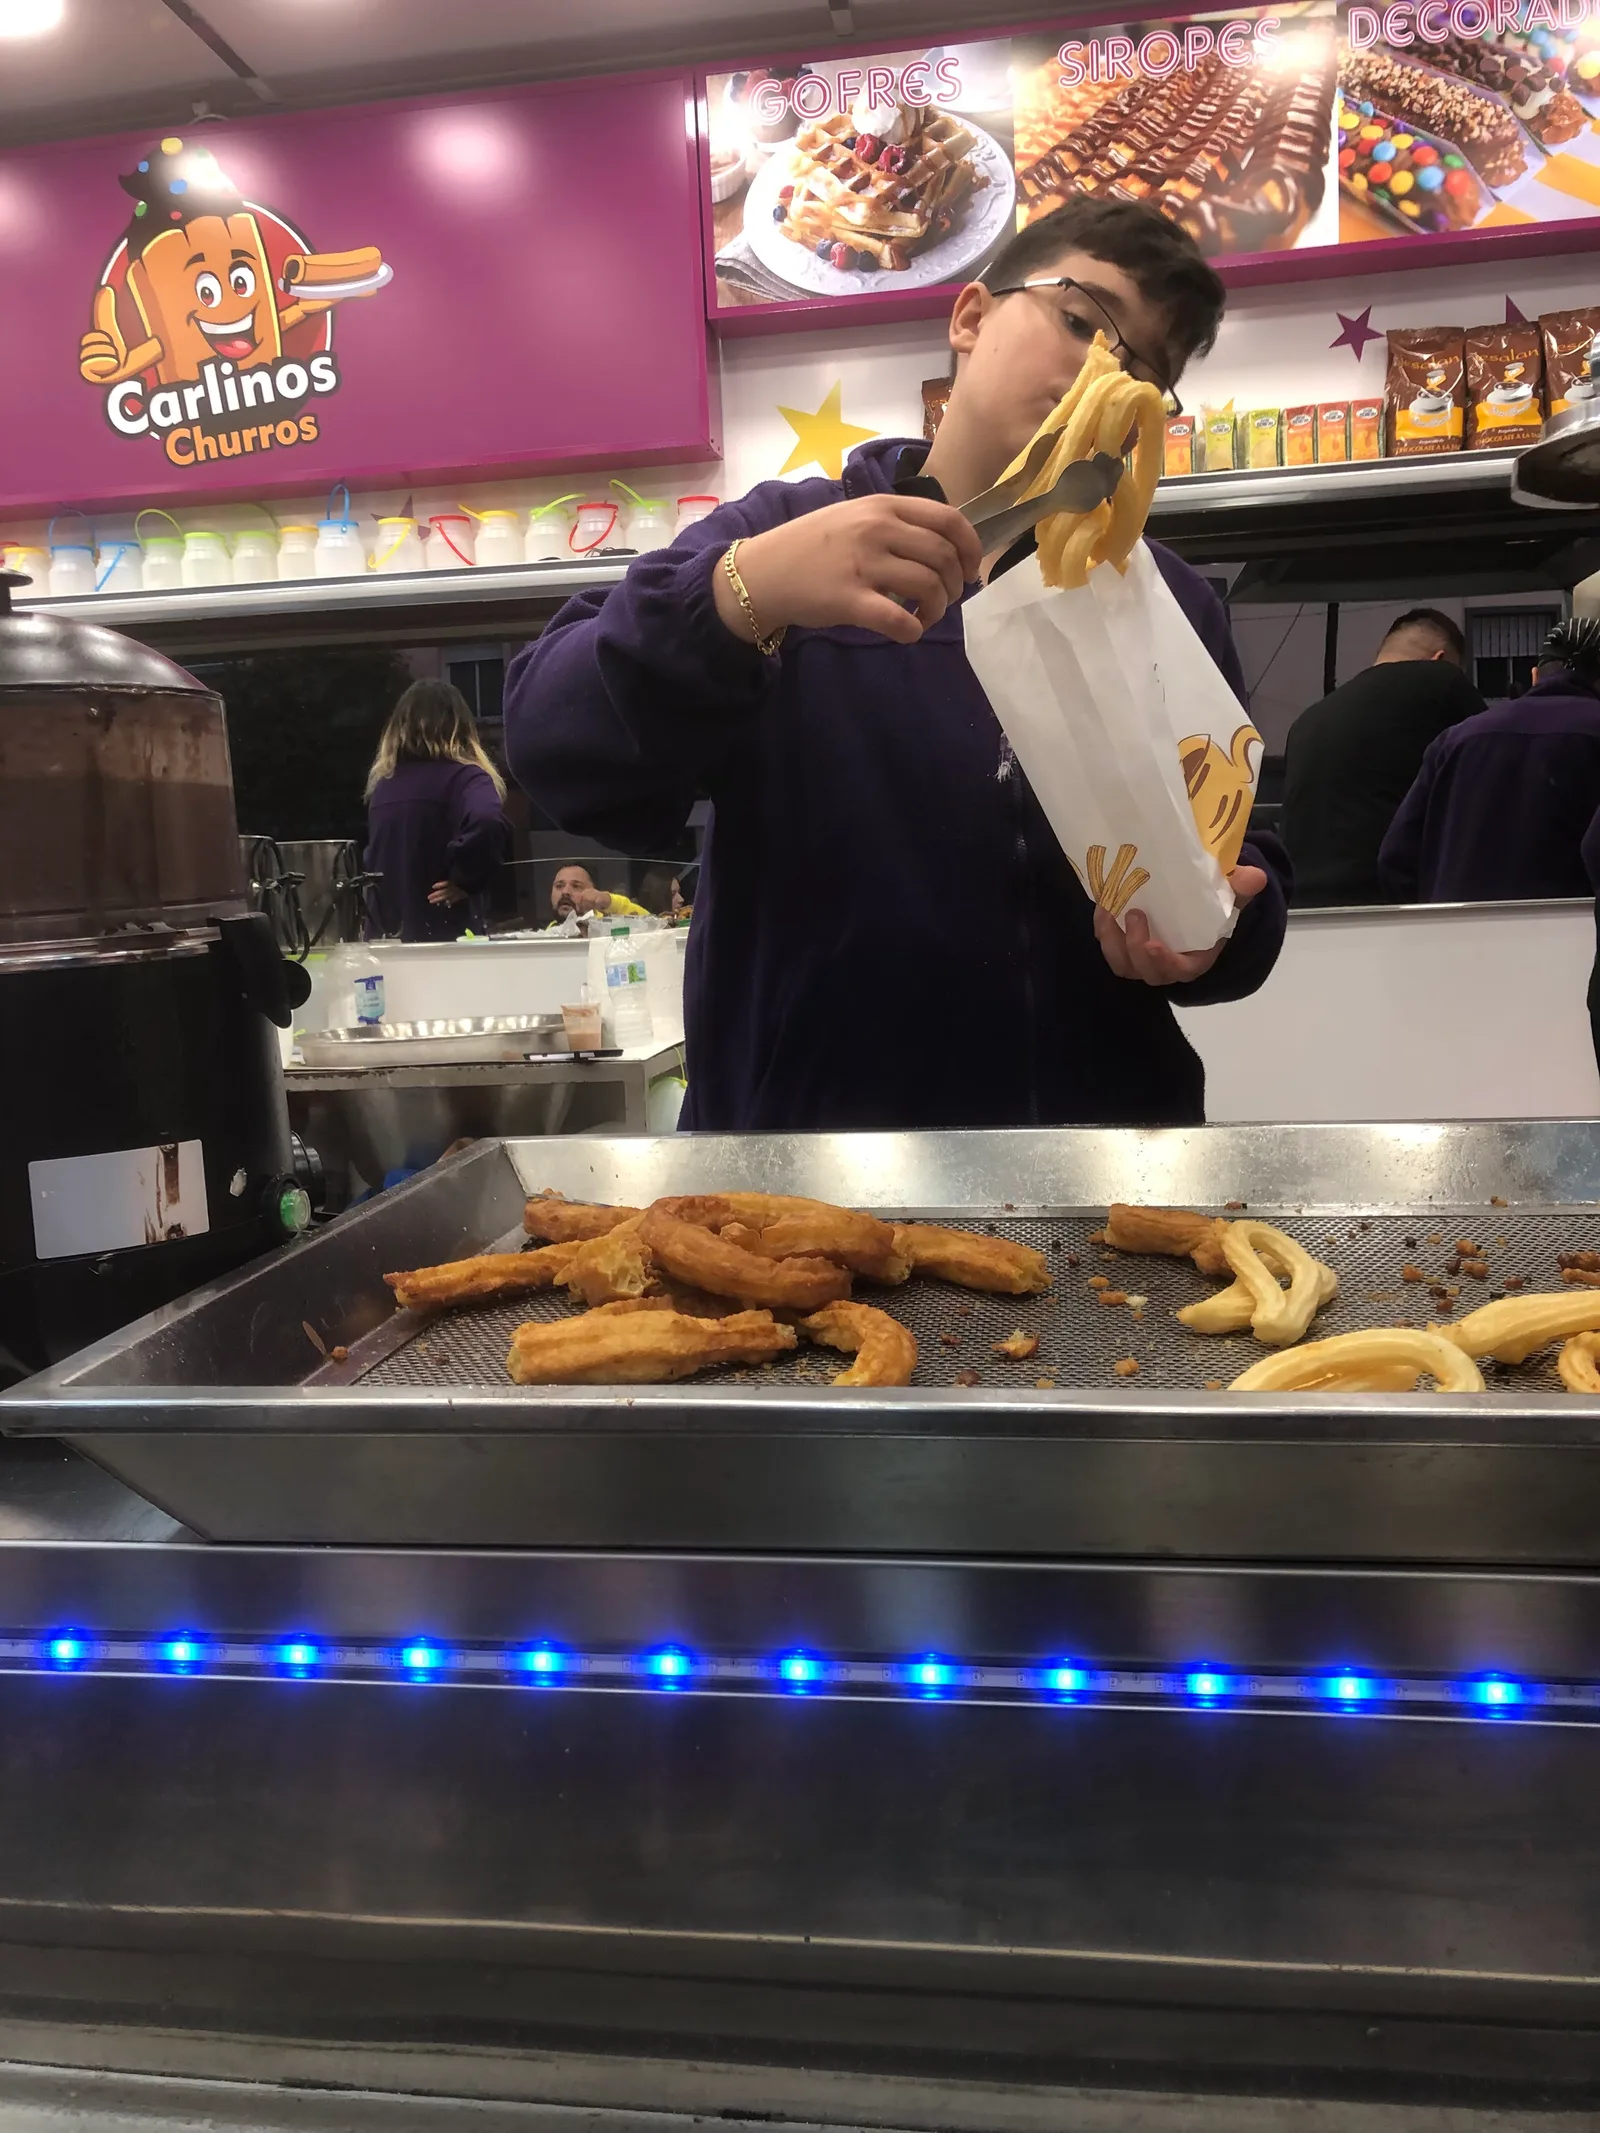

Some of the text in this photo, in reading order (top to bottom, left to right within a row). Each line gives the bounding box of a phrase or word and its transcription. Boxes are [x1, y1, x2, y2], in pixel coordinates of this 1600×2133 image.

[1058, 17, 1282, 88] SIROPES
[1348, 0, 1600, 49] DECORAD
[749, 57, 963, 126] GOFRES
[107, 355, 337, 434] Carlinos
[165, 415, 319, 466] Churros
[1475, 433, 1515, 446] CHOCOLATE
